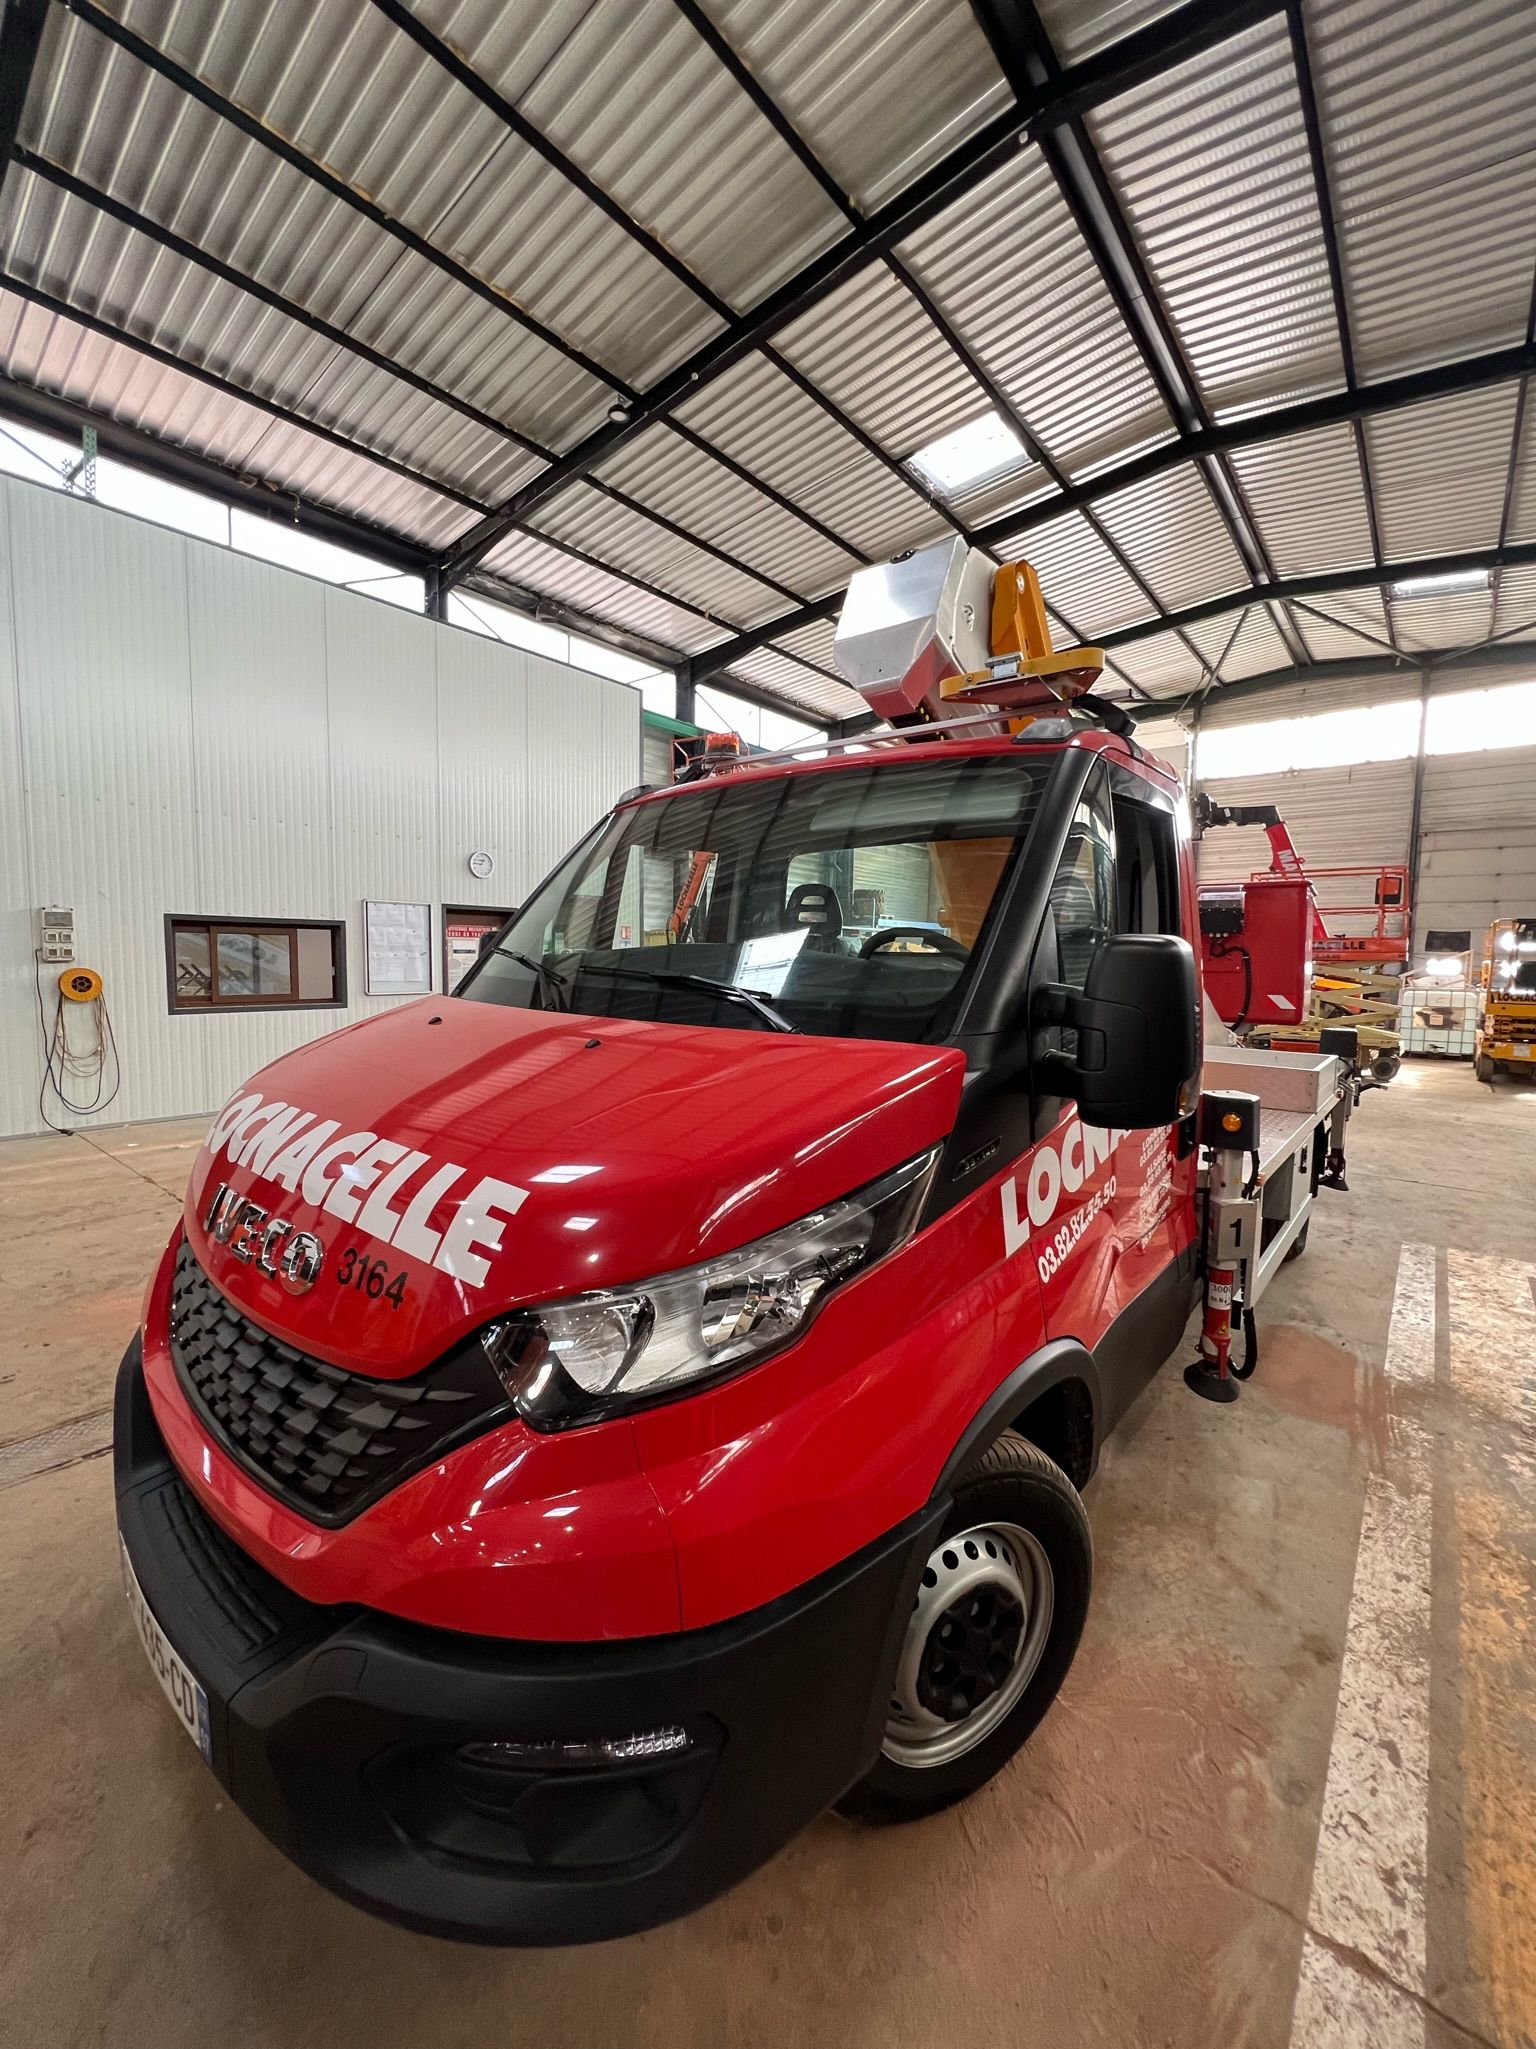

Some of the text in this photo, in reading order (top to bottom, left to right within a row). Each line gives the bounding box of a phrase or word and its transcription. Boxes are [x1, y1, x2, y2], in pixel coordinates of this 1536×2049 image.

[204, 1182, 323, 1296] IVECO
[1229, 1218, 1242, 1247] 1
[337, 1247, 408, 1310] 3164
